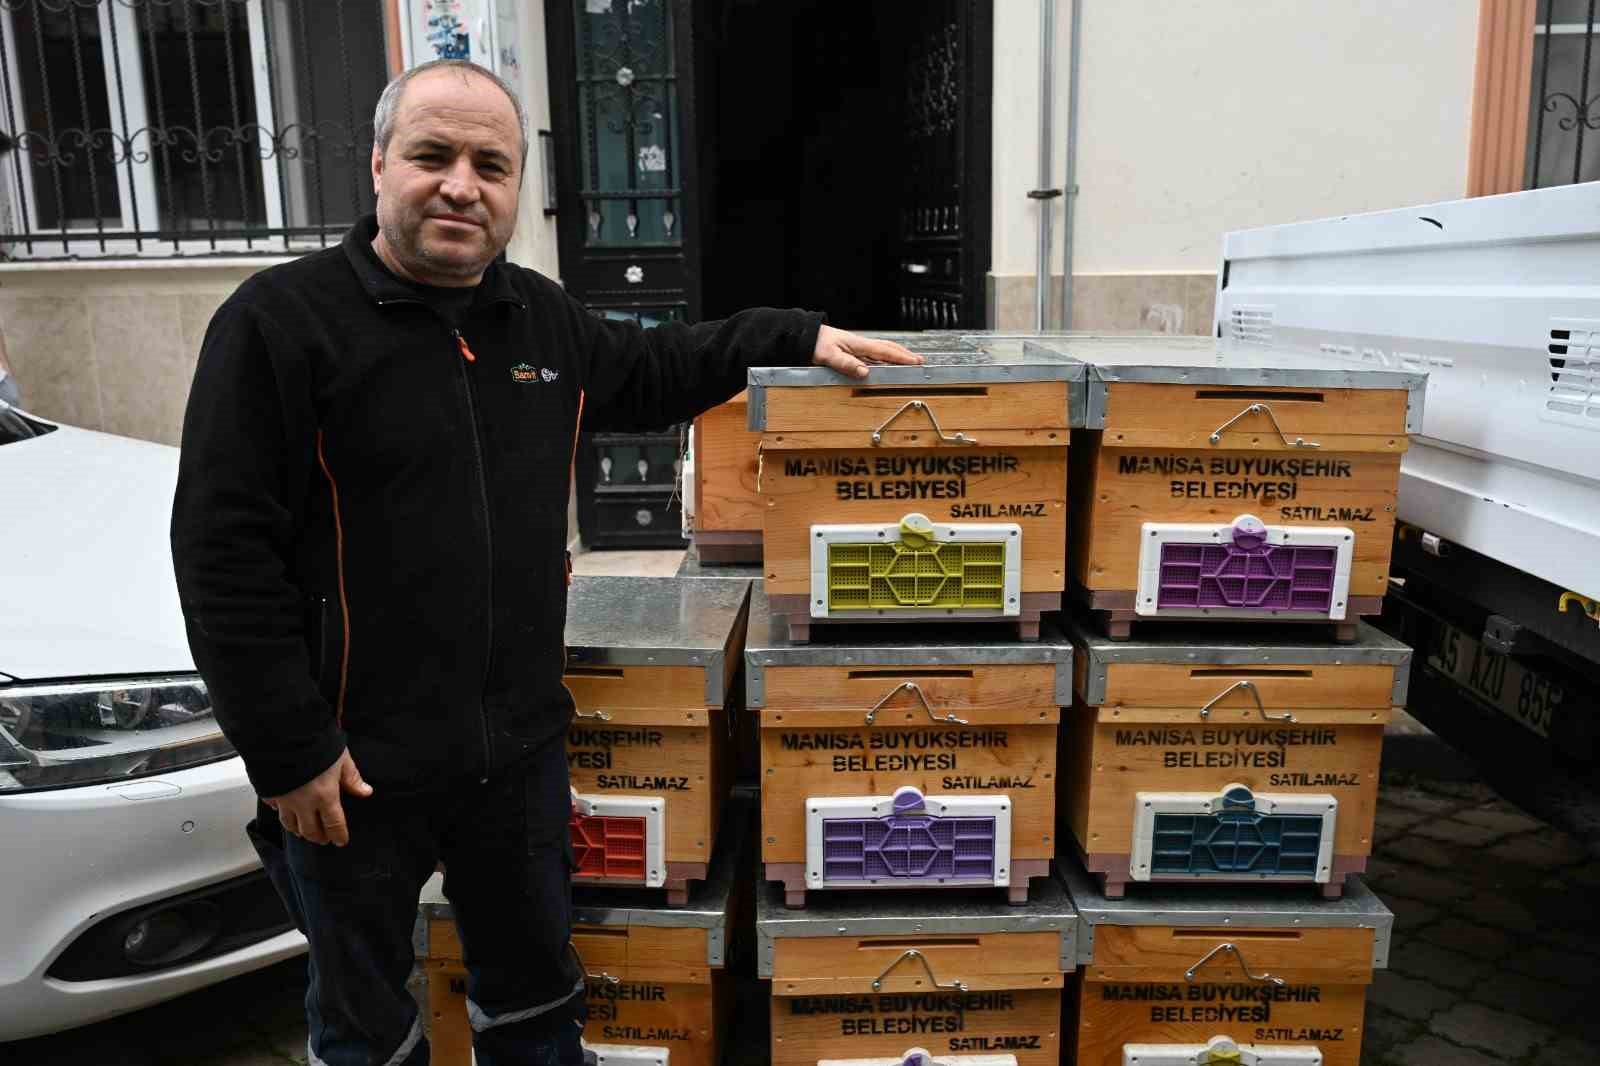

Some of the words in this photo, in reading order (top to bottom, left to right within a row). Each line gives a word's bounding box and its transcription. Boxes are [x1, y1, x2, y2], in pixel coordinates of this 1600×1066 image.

[950, 503, 1047, 518] SATILAMAZ
[1280, 506, 1376, 521] SATILAMAZ
[596, 774, 692, 790] SATILAMAZ
[942, 775, 1036, 789] SATILAMAZ
[1269, 773, 1360, 787] SATILAMAZ
[602, 1025, 691, 1041] SATILAMAZ
[1255, 1028, 1345, 1041] SATILAMAZ
[949, 1036, 1041, 1051] SATILAMAZ
